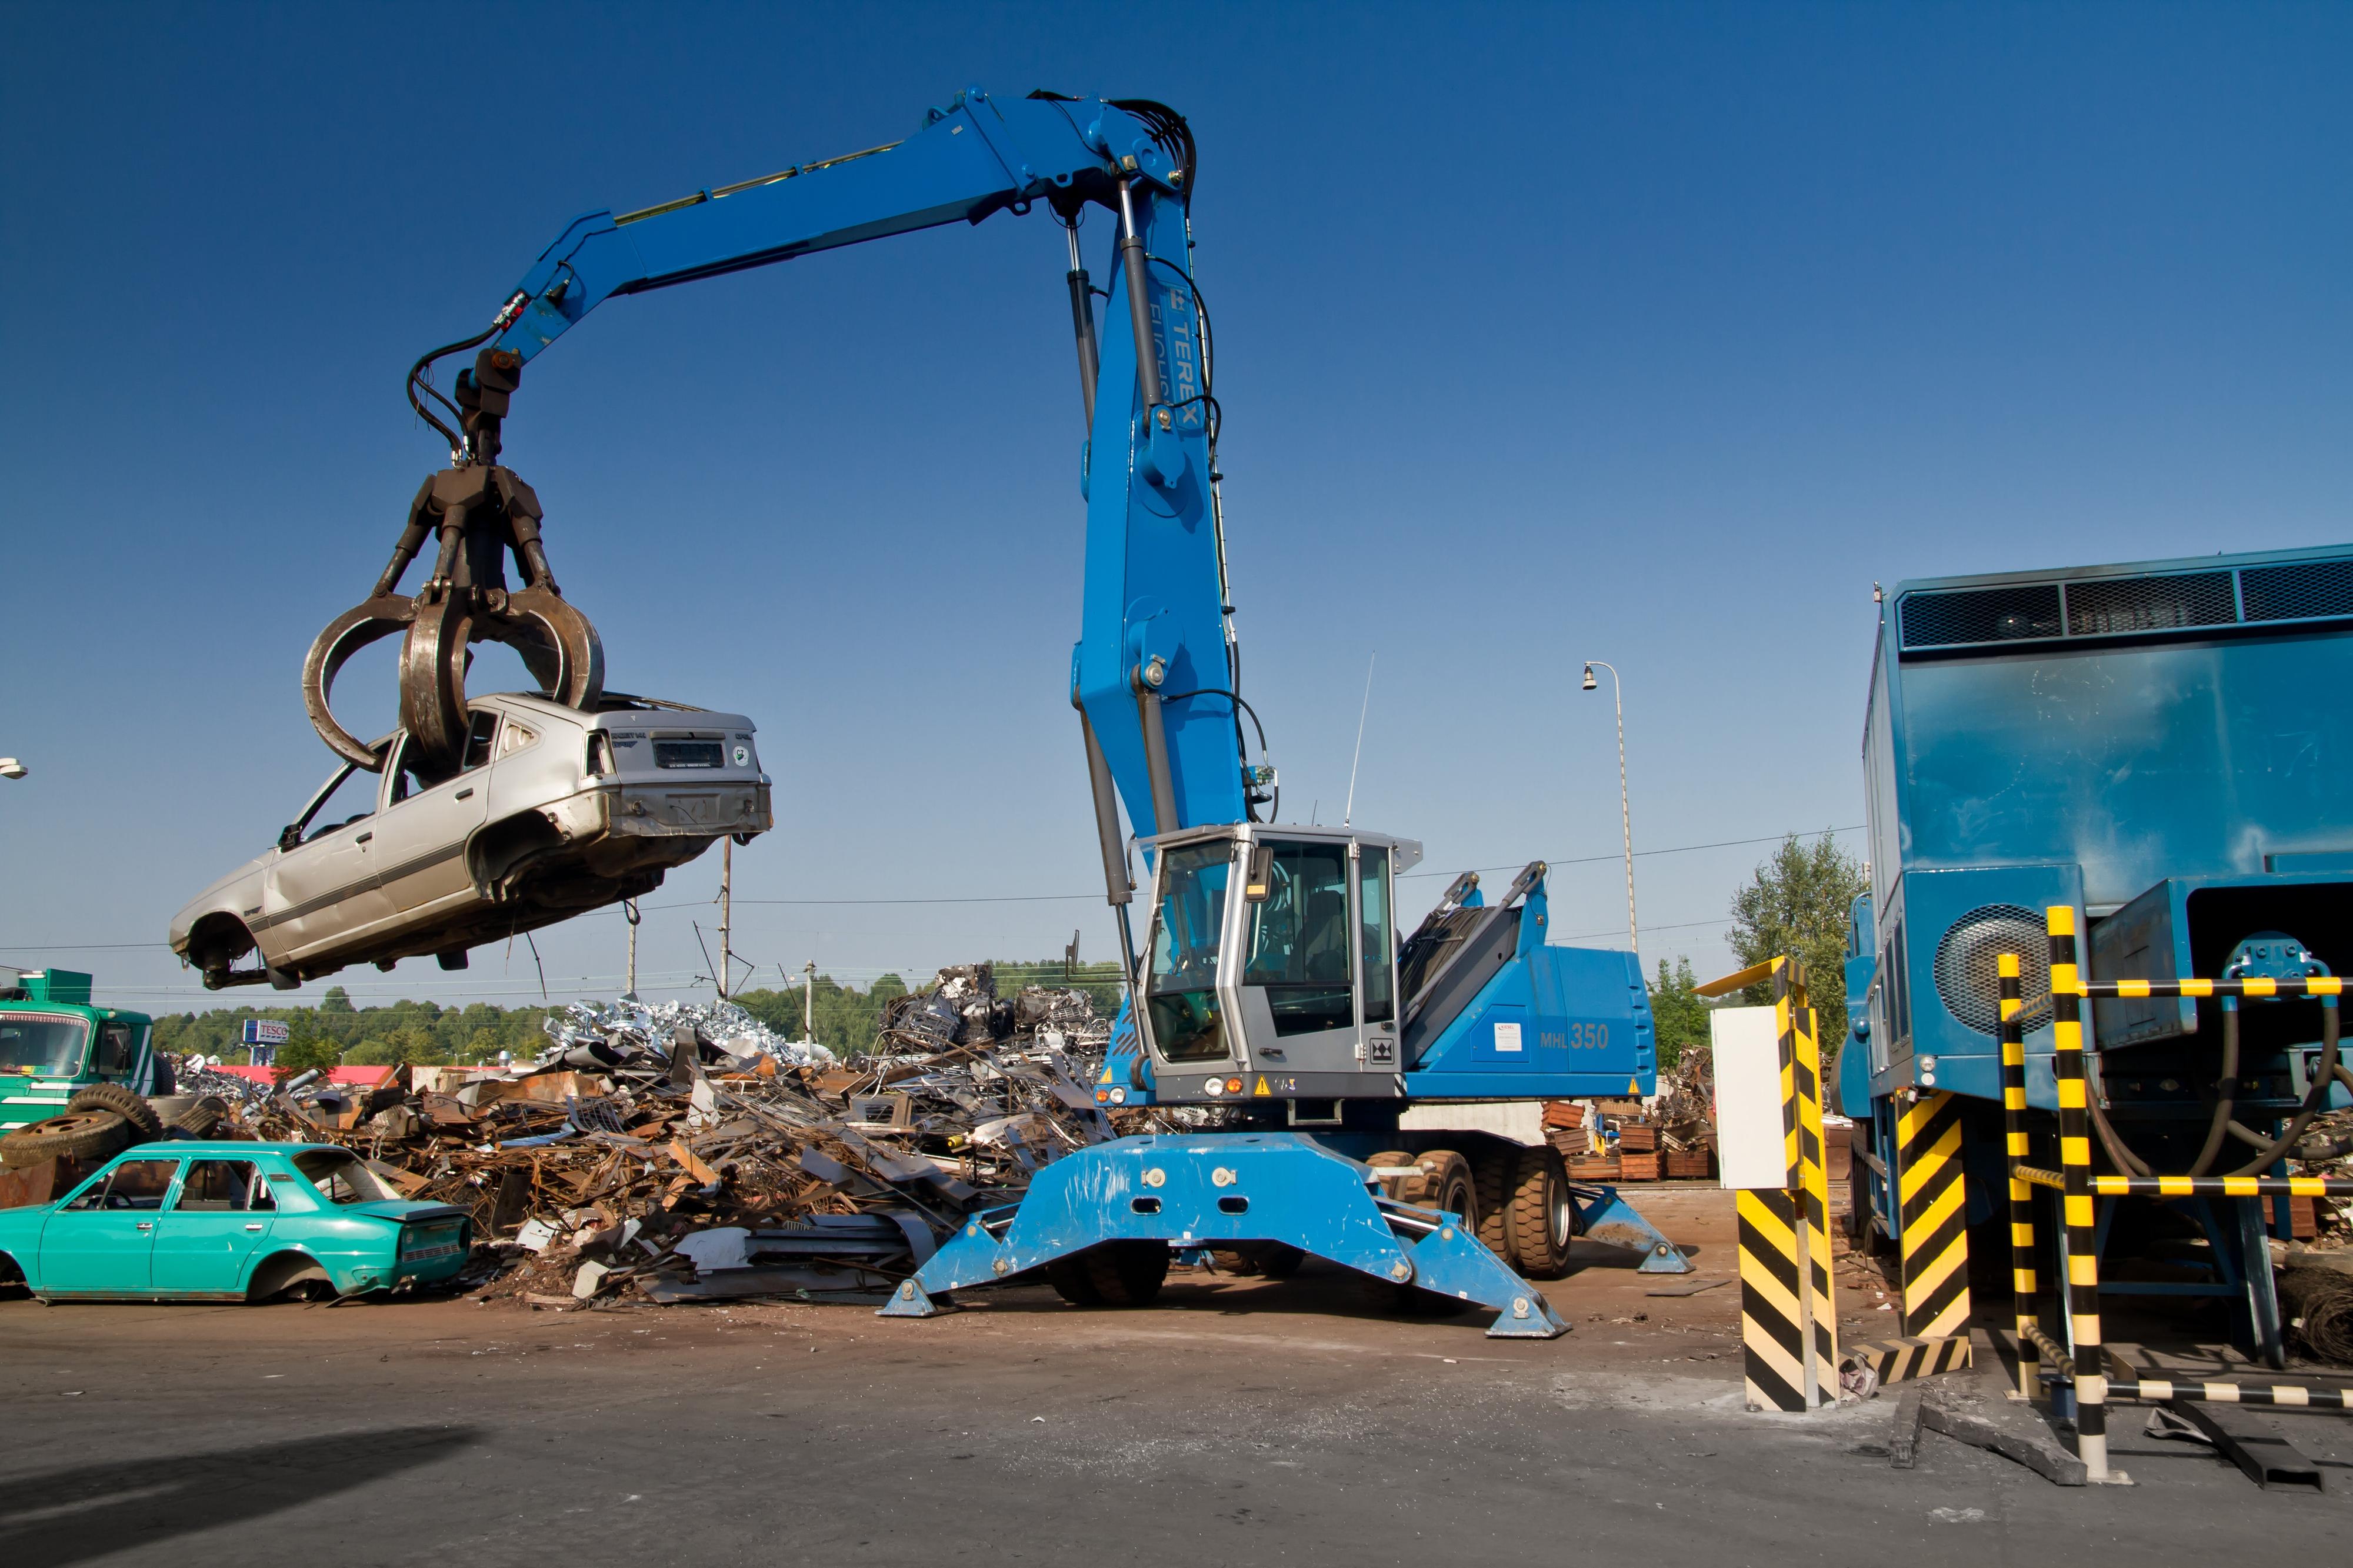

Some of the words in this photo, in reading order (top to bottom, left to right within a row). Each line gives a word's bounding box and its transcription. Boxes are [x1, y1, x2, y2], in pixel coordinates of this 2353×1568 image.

[1173, 322, 1198, 425] TEREX
[261, 1025, 288, 1036] TESCO
[1540, 1032, 1567, 1049] MHL
[1571, 1023, 1609, 1049] 350
